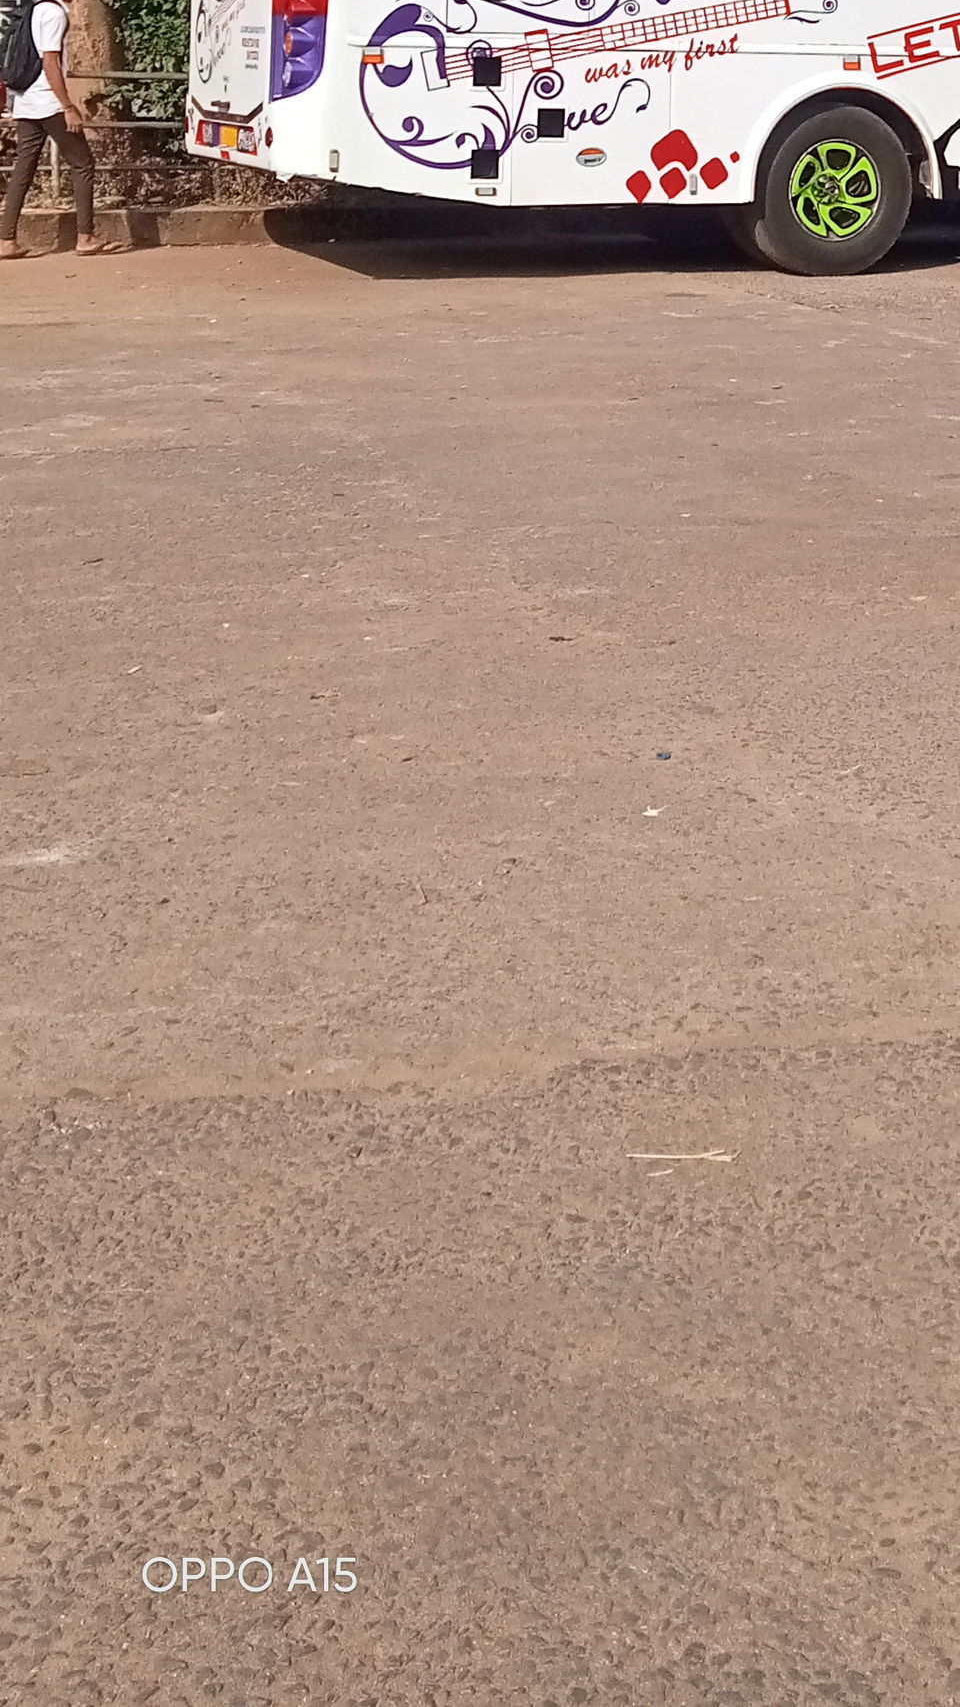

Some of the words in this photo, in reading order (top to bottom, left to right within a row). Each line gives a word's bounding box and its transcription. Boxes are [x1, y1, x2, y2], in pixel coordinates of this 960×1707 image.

[584, 58, 632, 84] was
[640, 51, 677, 73] my
[684, 33, 741, 71] first
